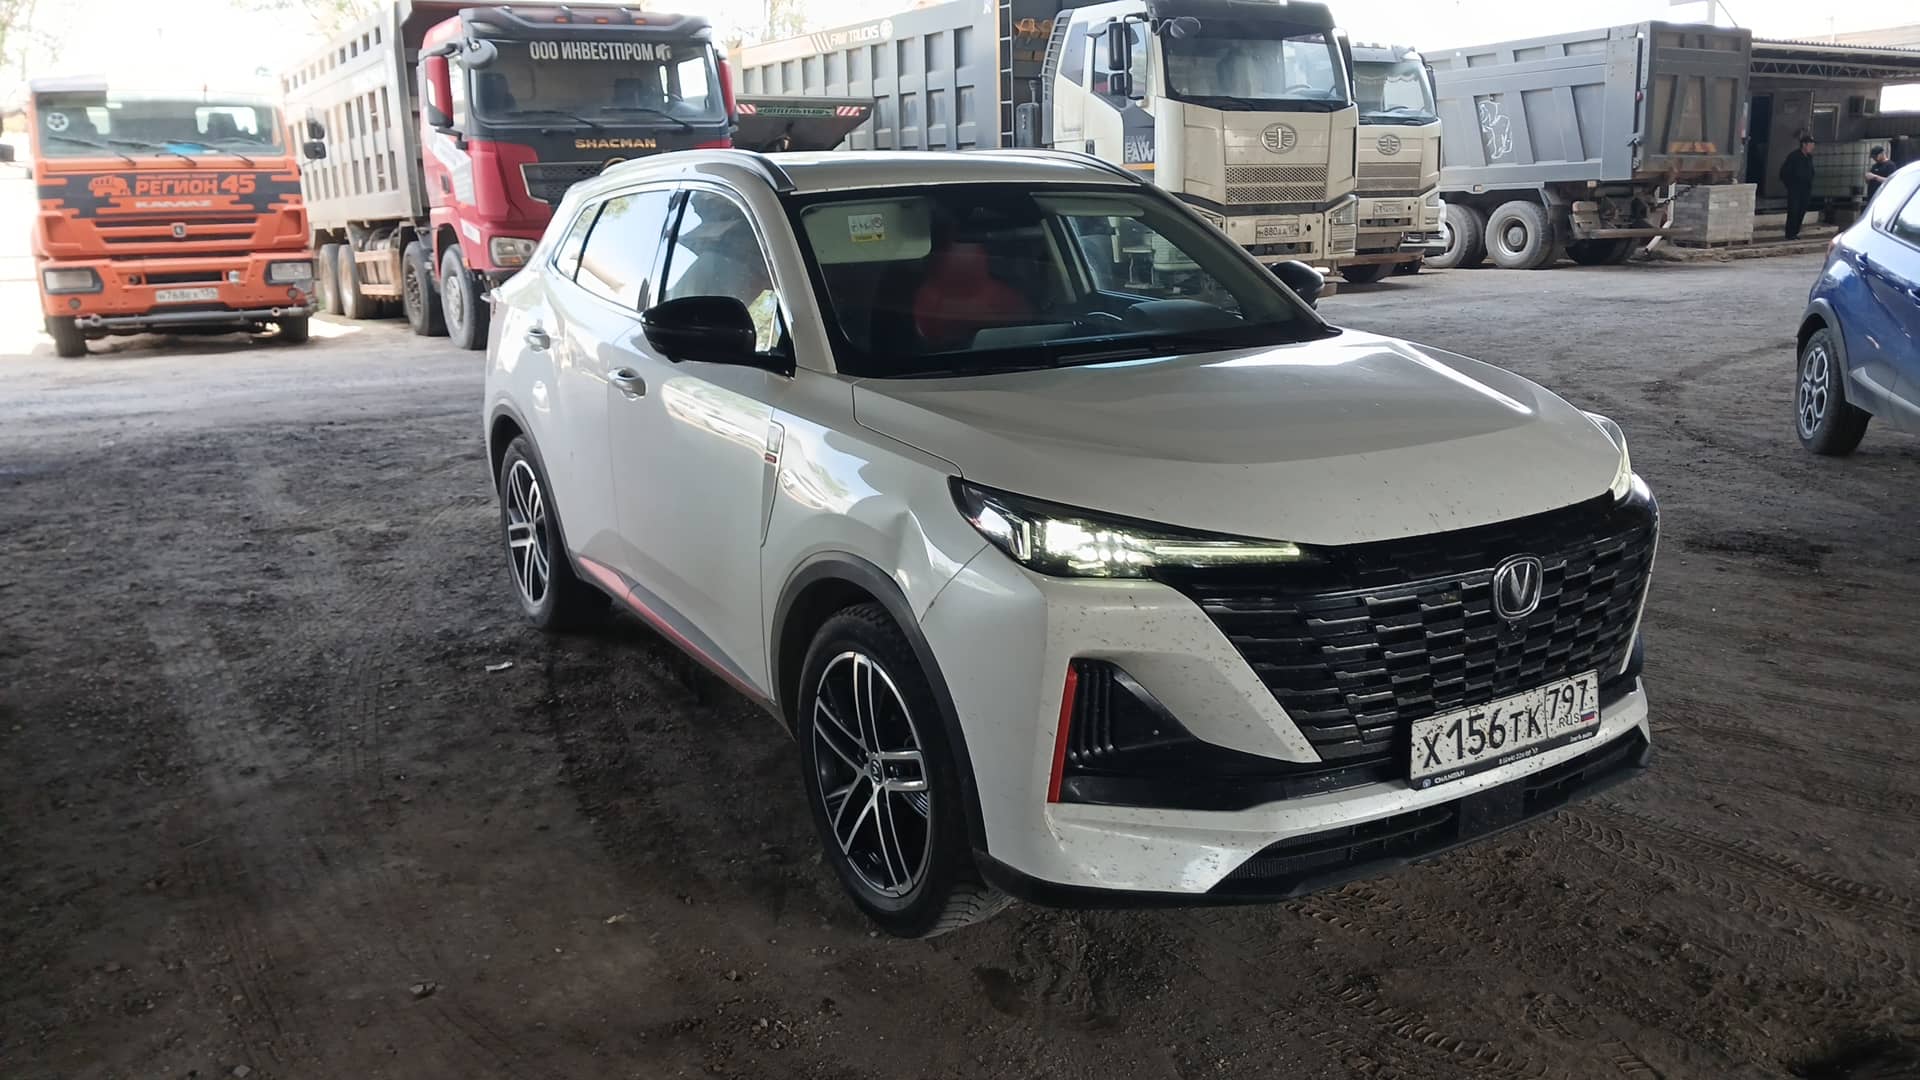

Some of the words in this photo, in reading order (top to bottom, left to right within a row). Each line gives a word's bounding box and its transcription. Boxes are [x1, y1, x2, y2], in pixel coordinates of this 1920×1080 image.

[529, 41, 559, 60] ООО
[561, 41, 654, 61] ИНВЕСТПРОМ
[575, 138, 657, 149] SHACMAN
[135, 179, 218, 195] РЕГИОН
[220, 174, 256, 194] 45
[1423, 704, 1542, 768] Х156ТК
[1547, 680, 1588, 721] 797
[1558, 712, 1580, 728] RUS
